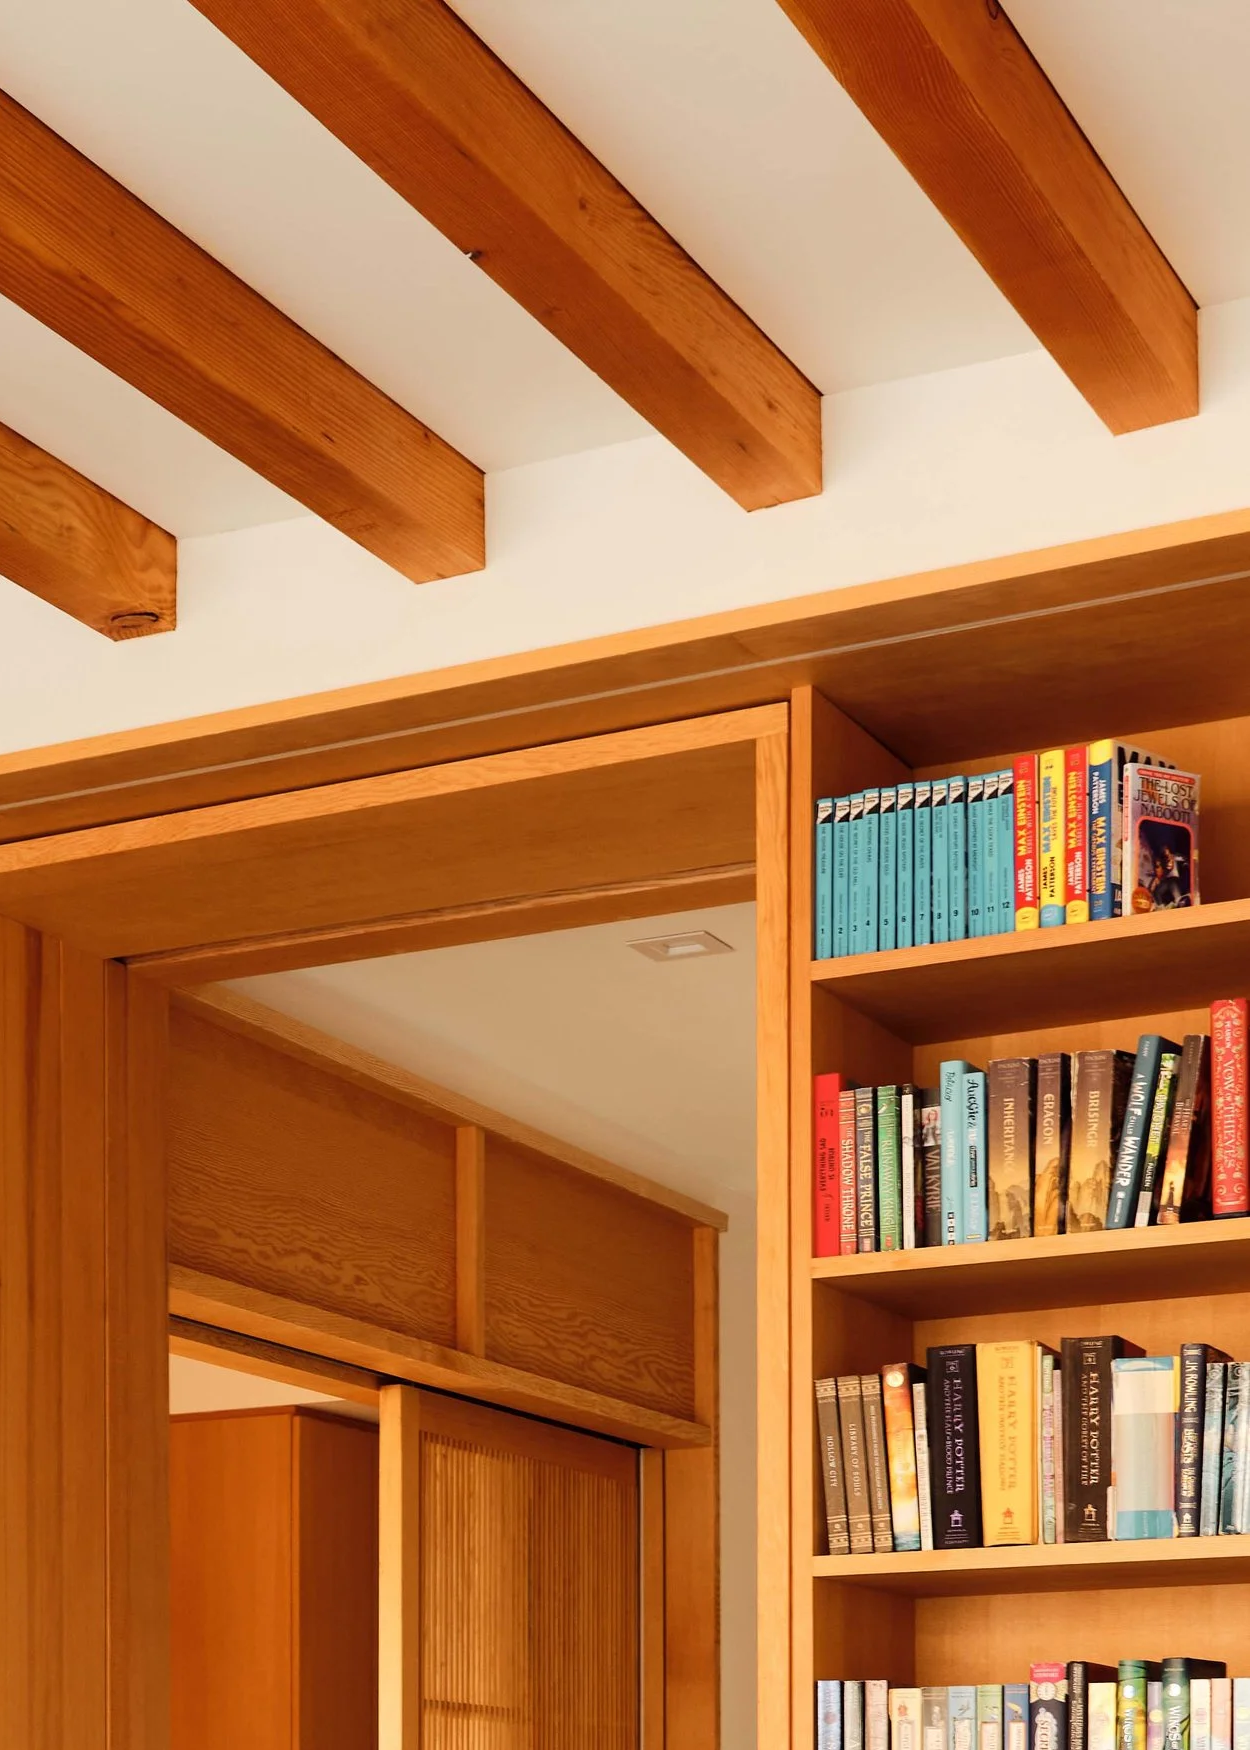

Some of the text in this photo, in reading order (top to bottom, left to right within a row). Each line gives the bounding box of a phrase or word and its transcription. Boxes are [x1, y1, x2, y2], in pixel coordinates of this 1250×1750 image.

[1066, 771, 1078, 849] MAX EINSTEIN
[1133, 790, 1197, 811] JEWELS OF
[1139, 777, 1193, 798] THE LOST
[1016, 780, 1028, 857] MAX EINSTEIN
[1074, 852, 1082, 894] PATTERSON
[1095, 816, 1106, 894] MAX EINSTEIN
[1025, 858, 1033, 902] PATTERSON
[1222, 1060, 1233, 1092] VOW
[1043, 1093, 1055, 1145] ERAGON
[1086, 1090, 1100, 1148] BRISINGR
[1130, 1082, 1148, 1116] WOLF
[1223, 1103, 1235, 1169] THIEVES
[841, 1139, 854, 1185] SHADOW
[859, 1144, 871, 1180] FALSE
[1115, 1136, 1141, 1187] WANDER
[1144, 1162, 1154, 1187] PAULSEN
[842, 1188, 855, 1231] THRONE
[860, 1184, 872, 1227] PRINCE
[1184, 1374, 1198, 1412] ROWLING
[953, 1377, 965, 1492] HARRY POTTER
[1088, 1371, 1100, 1484] HARRY POTTER
[826, 1436, 837, 1487] HOLLOW CITY
[849, 1424, 861, 1496] LIBRARY OF SOULS
[1167, 1706, 1182, 1741] WINGS
